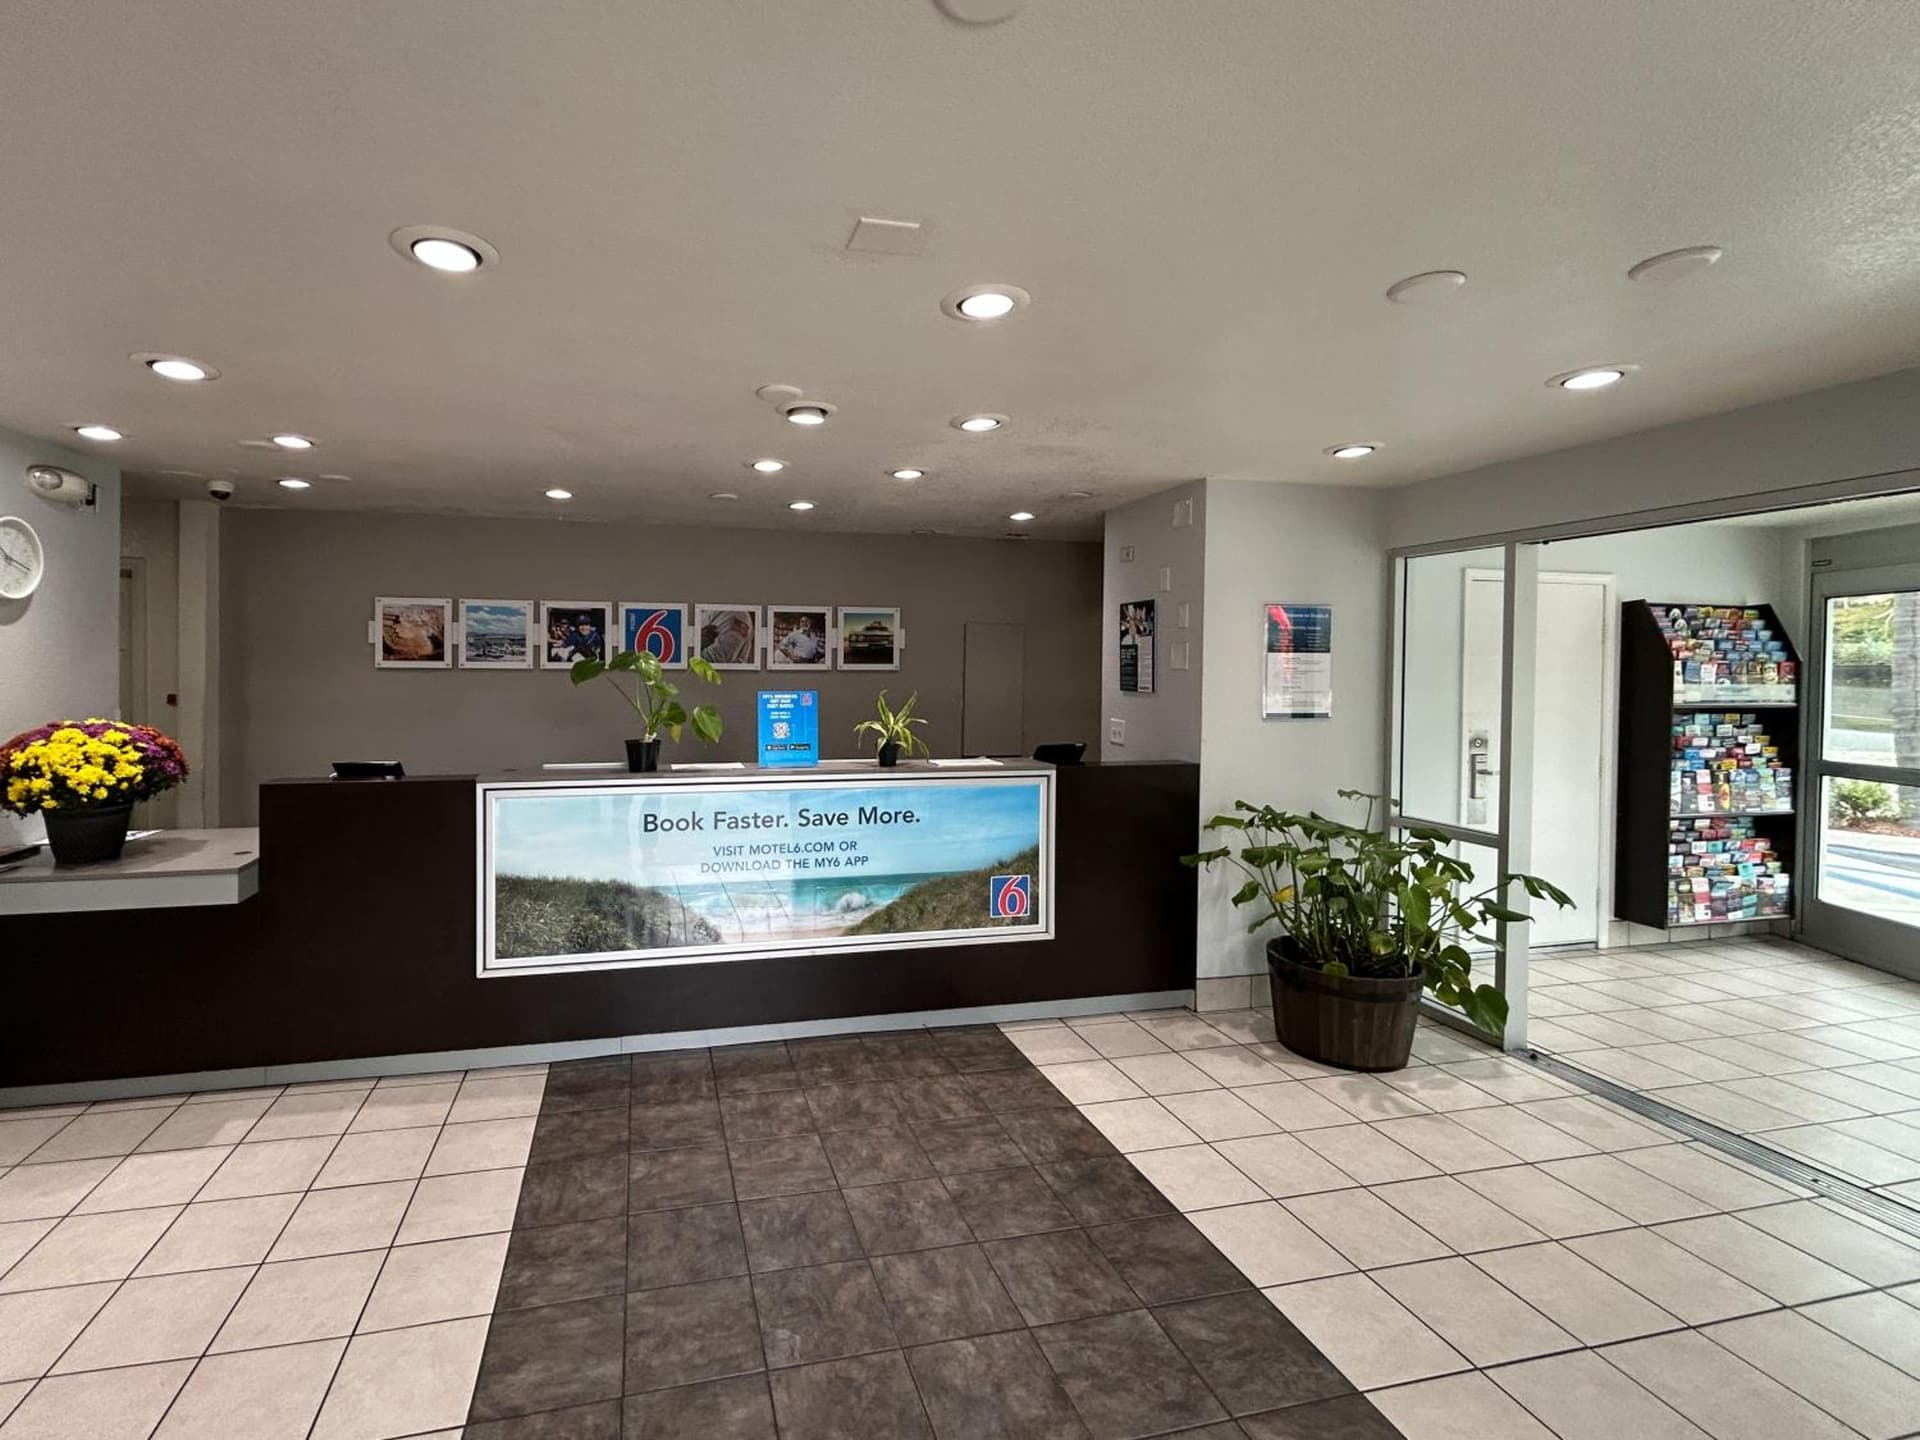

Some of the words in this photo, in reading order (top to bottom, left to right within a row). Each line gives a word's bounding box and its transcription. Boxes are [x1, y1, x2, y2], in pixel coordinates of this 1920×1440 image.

[643, 811, 704, 832] Book
[714, 808, 788, 830] Faster.
[797, 808, 849, 827] Save
[858, 806, 921, 825] More.
[713, 845, 745, 857] VISIT
[750, 841, 834, 856] MOTEL6.COM
[839, 840, 858, 852] OR
[701, 859, 781, 873] DOWNLOAD
[786, 858, 810, 869] THE
[814, 857, 840, 869] MY6
[844, 855, 869, 867] APP
[998, 876, 1026, 916] 6
